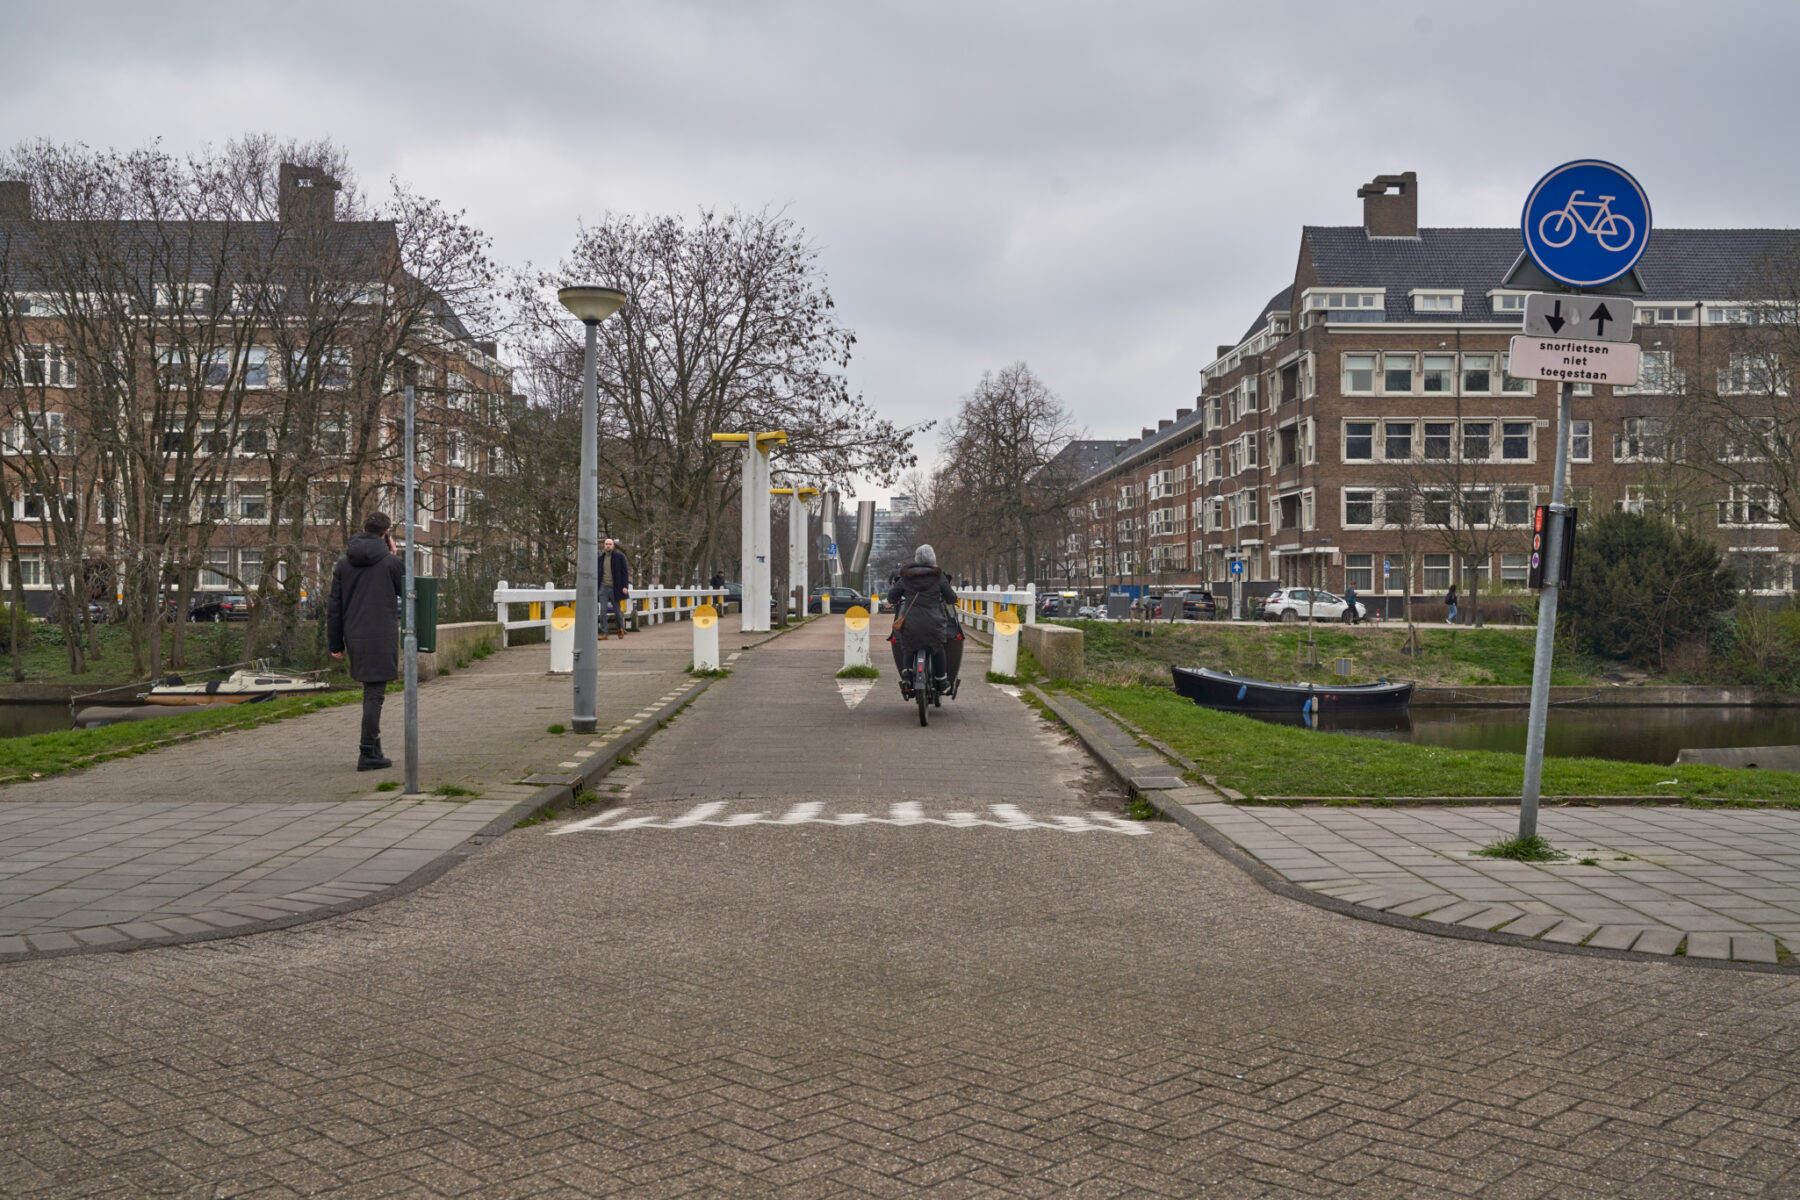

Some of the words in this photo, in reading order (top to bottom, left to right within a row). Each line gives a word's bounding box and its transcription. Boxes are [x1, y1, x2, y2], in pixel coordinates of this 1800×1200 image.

[1540, 342, 1609, 354] snorfietsen
[1563, 356, 1587, 366] niet
[1540, 367, 1607, 380] toegestaan
